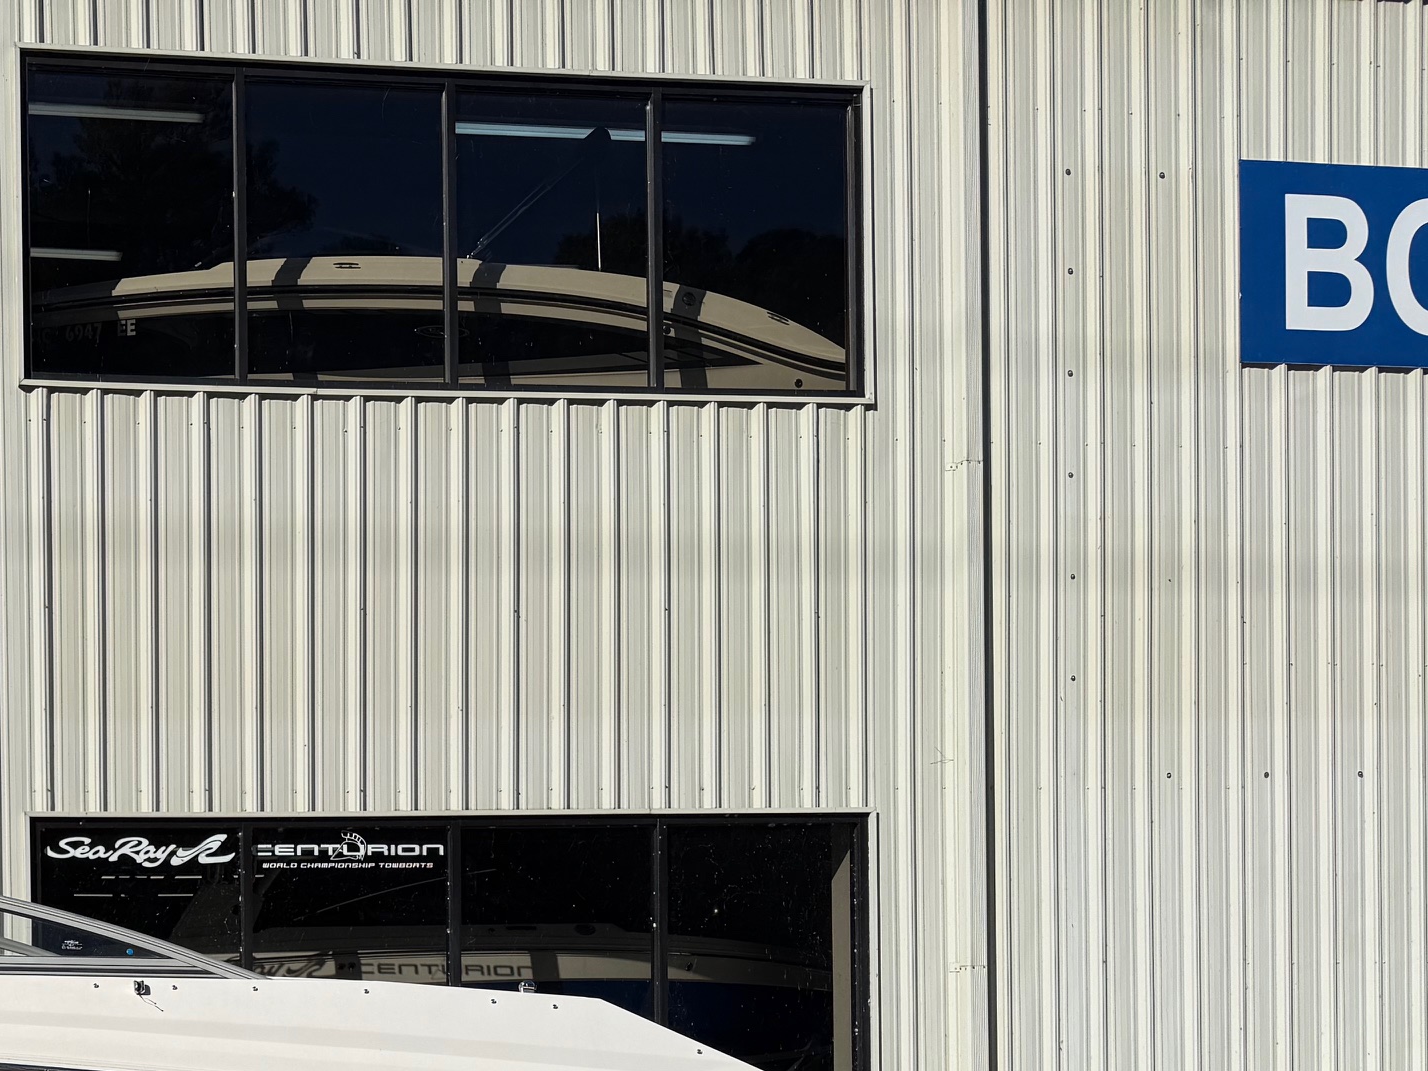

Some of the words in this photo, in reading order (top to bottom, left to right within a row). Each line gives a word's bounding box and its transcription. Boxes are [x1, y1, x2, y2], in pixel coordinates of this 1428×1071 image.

[46, 836, 110, 860] Sea
[105, 836, 174, 868] Ray
[257, 843, 445, 859] CENTURION
[262, 861, 298, 870] WORLD
[300, 861, 376, 870] CHAMPIONSHIP
